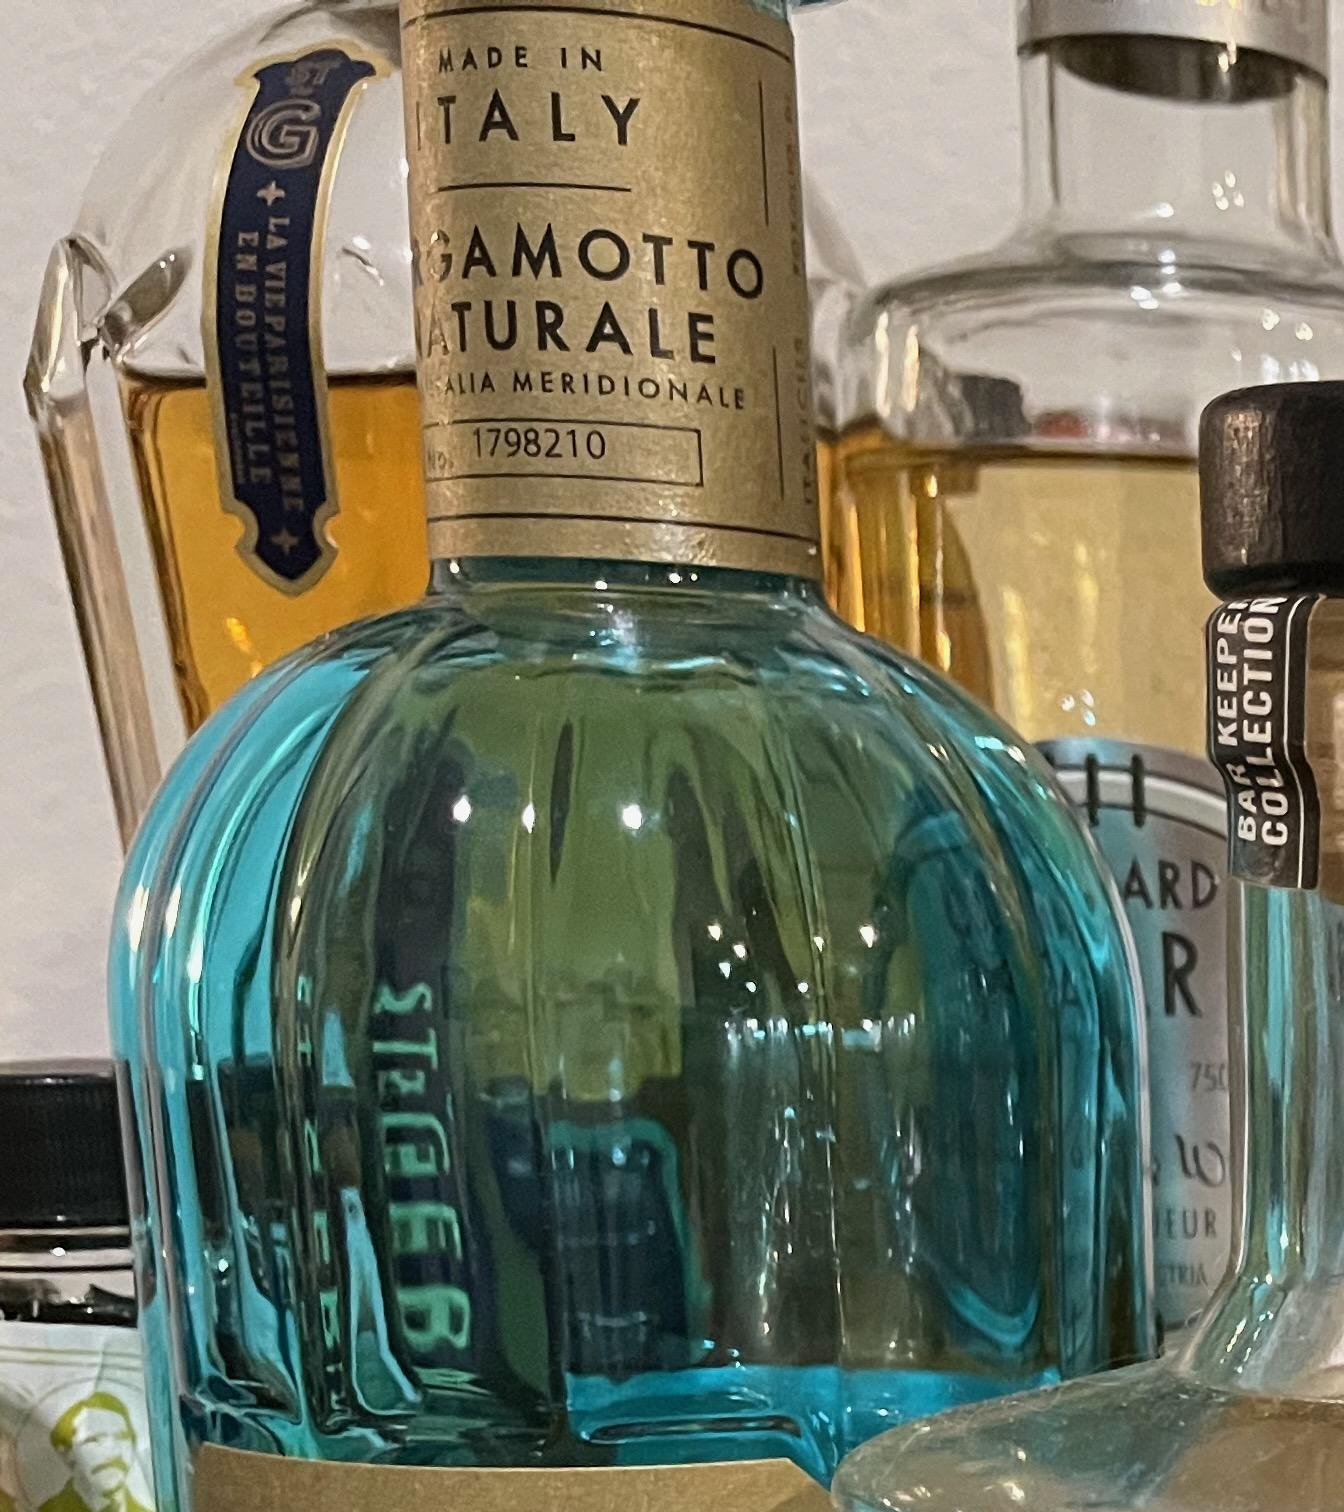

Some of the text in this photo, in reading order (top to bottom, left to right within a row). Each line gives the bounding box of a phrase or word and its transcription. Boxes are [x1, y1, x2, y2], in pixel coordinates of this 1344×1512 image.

[438, 45, 604, 73] MADE IN
[412, 222, 766, 300] GAMOTTO
[417, 300, 717, 365] ATURALE
[512, 371, 746, 411] MERIDIONALE
[471, 426, 608, 461] 1798210
[1242, 596, 1289, 847] COLLECTION
[1226, 762, 1258, 842] BAR
